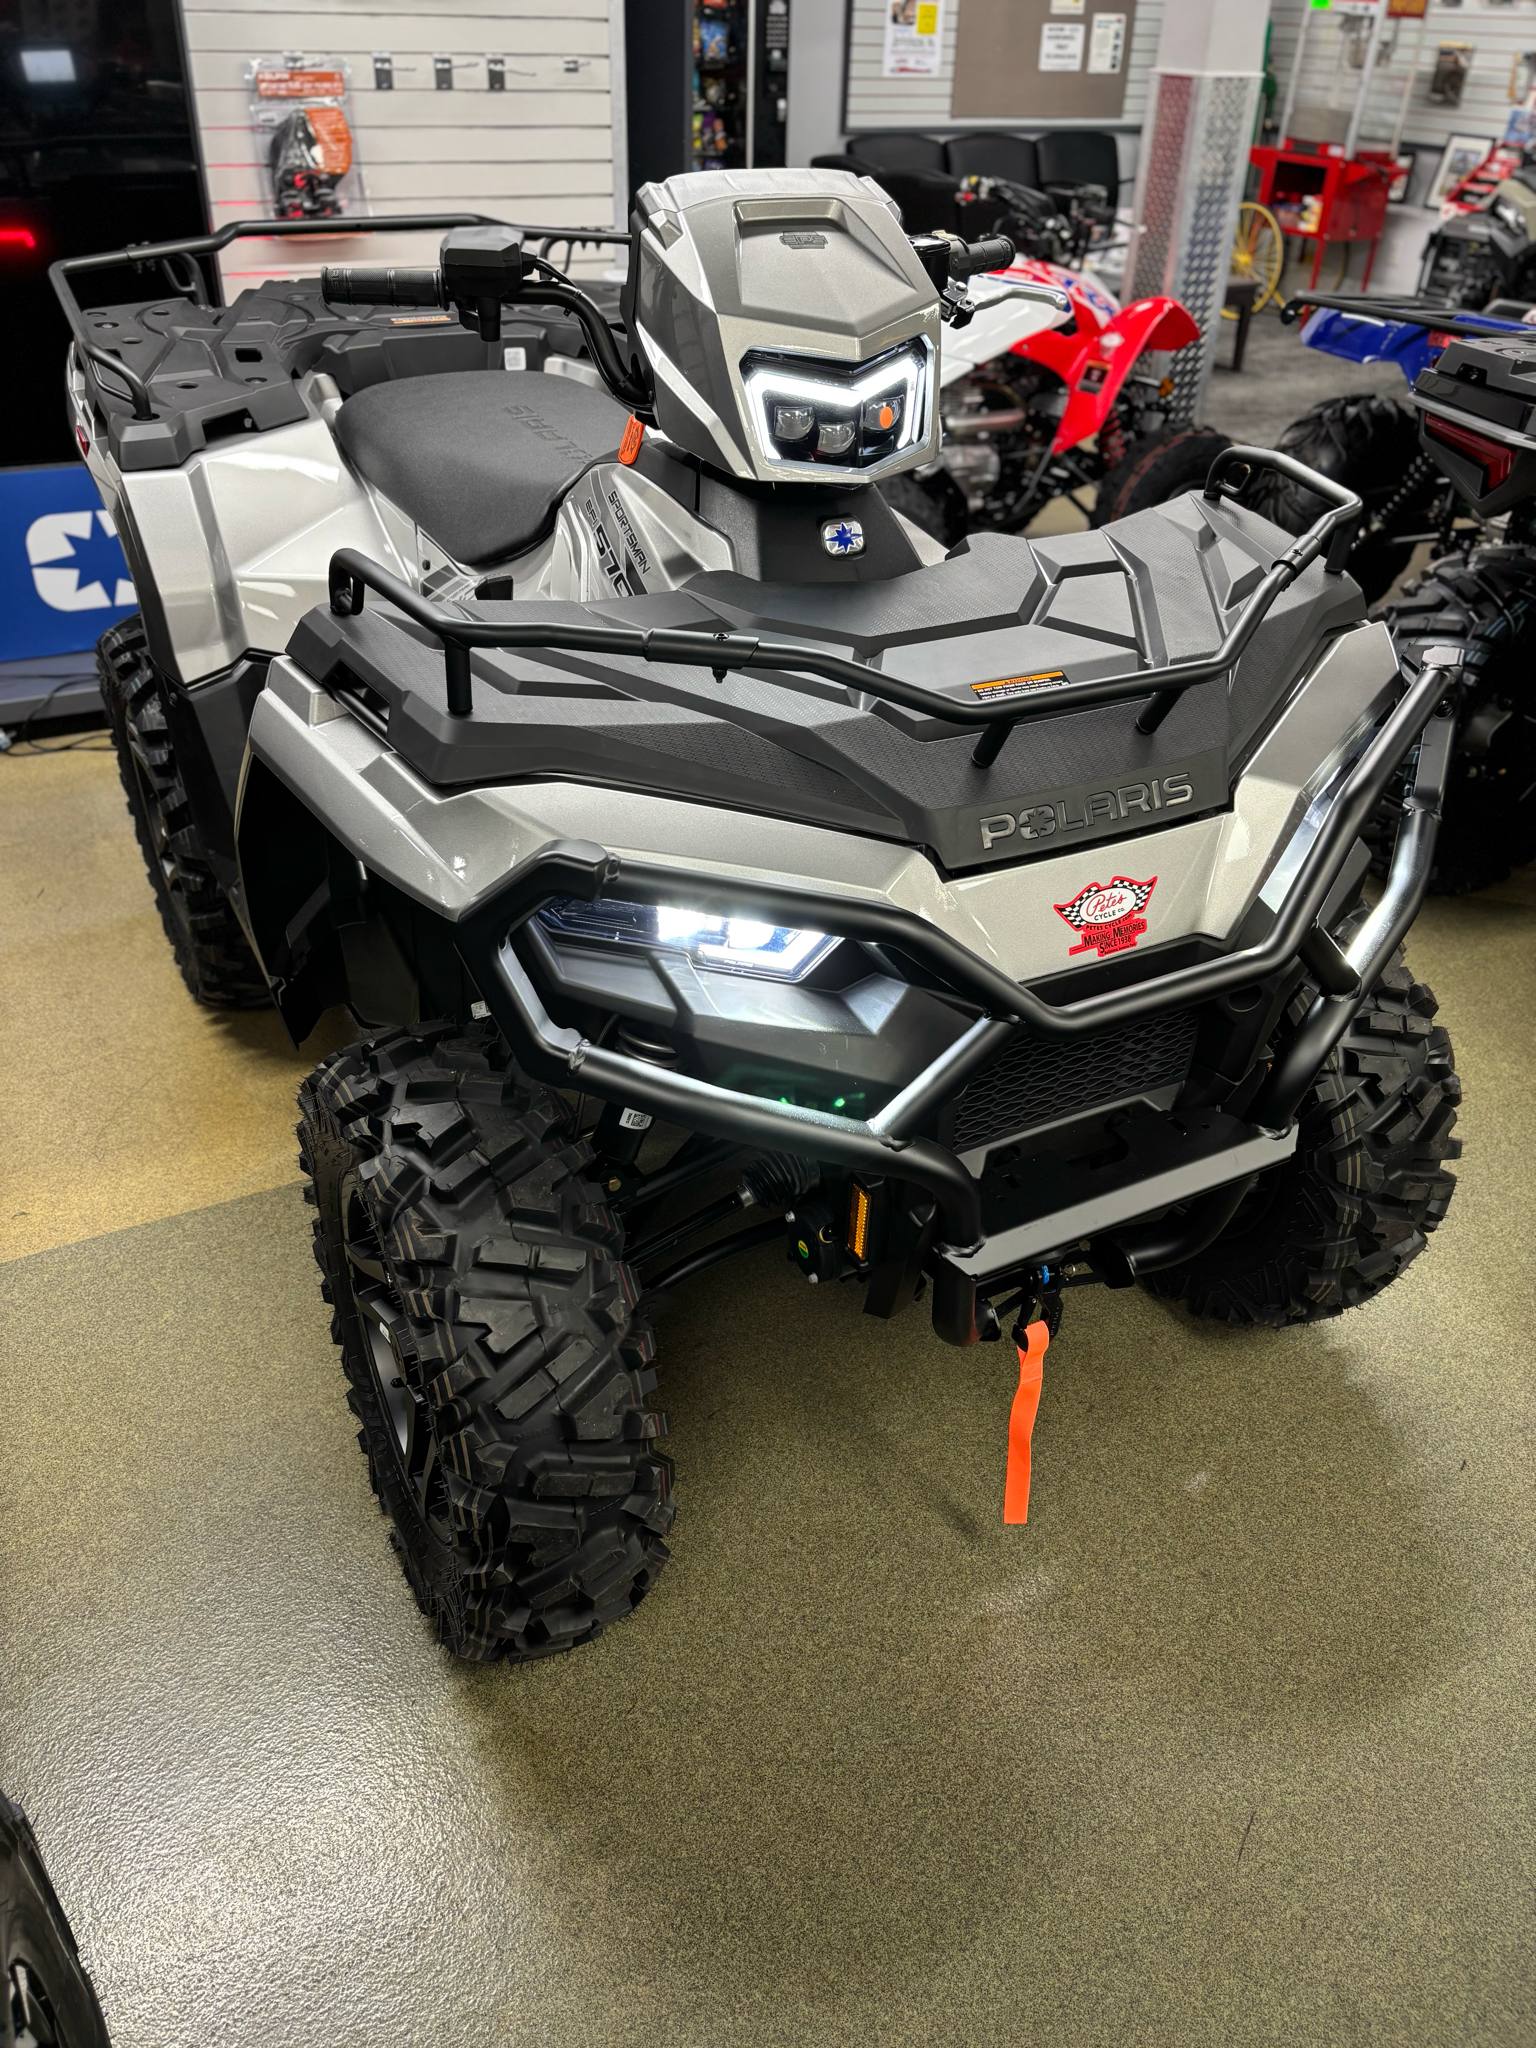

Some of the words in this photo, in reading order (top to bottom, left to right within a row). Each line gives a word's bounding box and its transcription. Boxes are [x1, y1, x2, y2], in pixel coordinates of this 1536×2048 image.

[585, 498, 597, 527] EFI
[593, 523, 633, 597] 570
[608, 490, 651, 574] SPORTSMAN
[979, 772, 1194, 850] POLARIS
[1094, 910, 1117, 921] CYCLE
